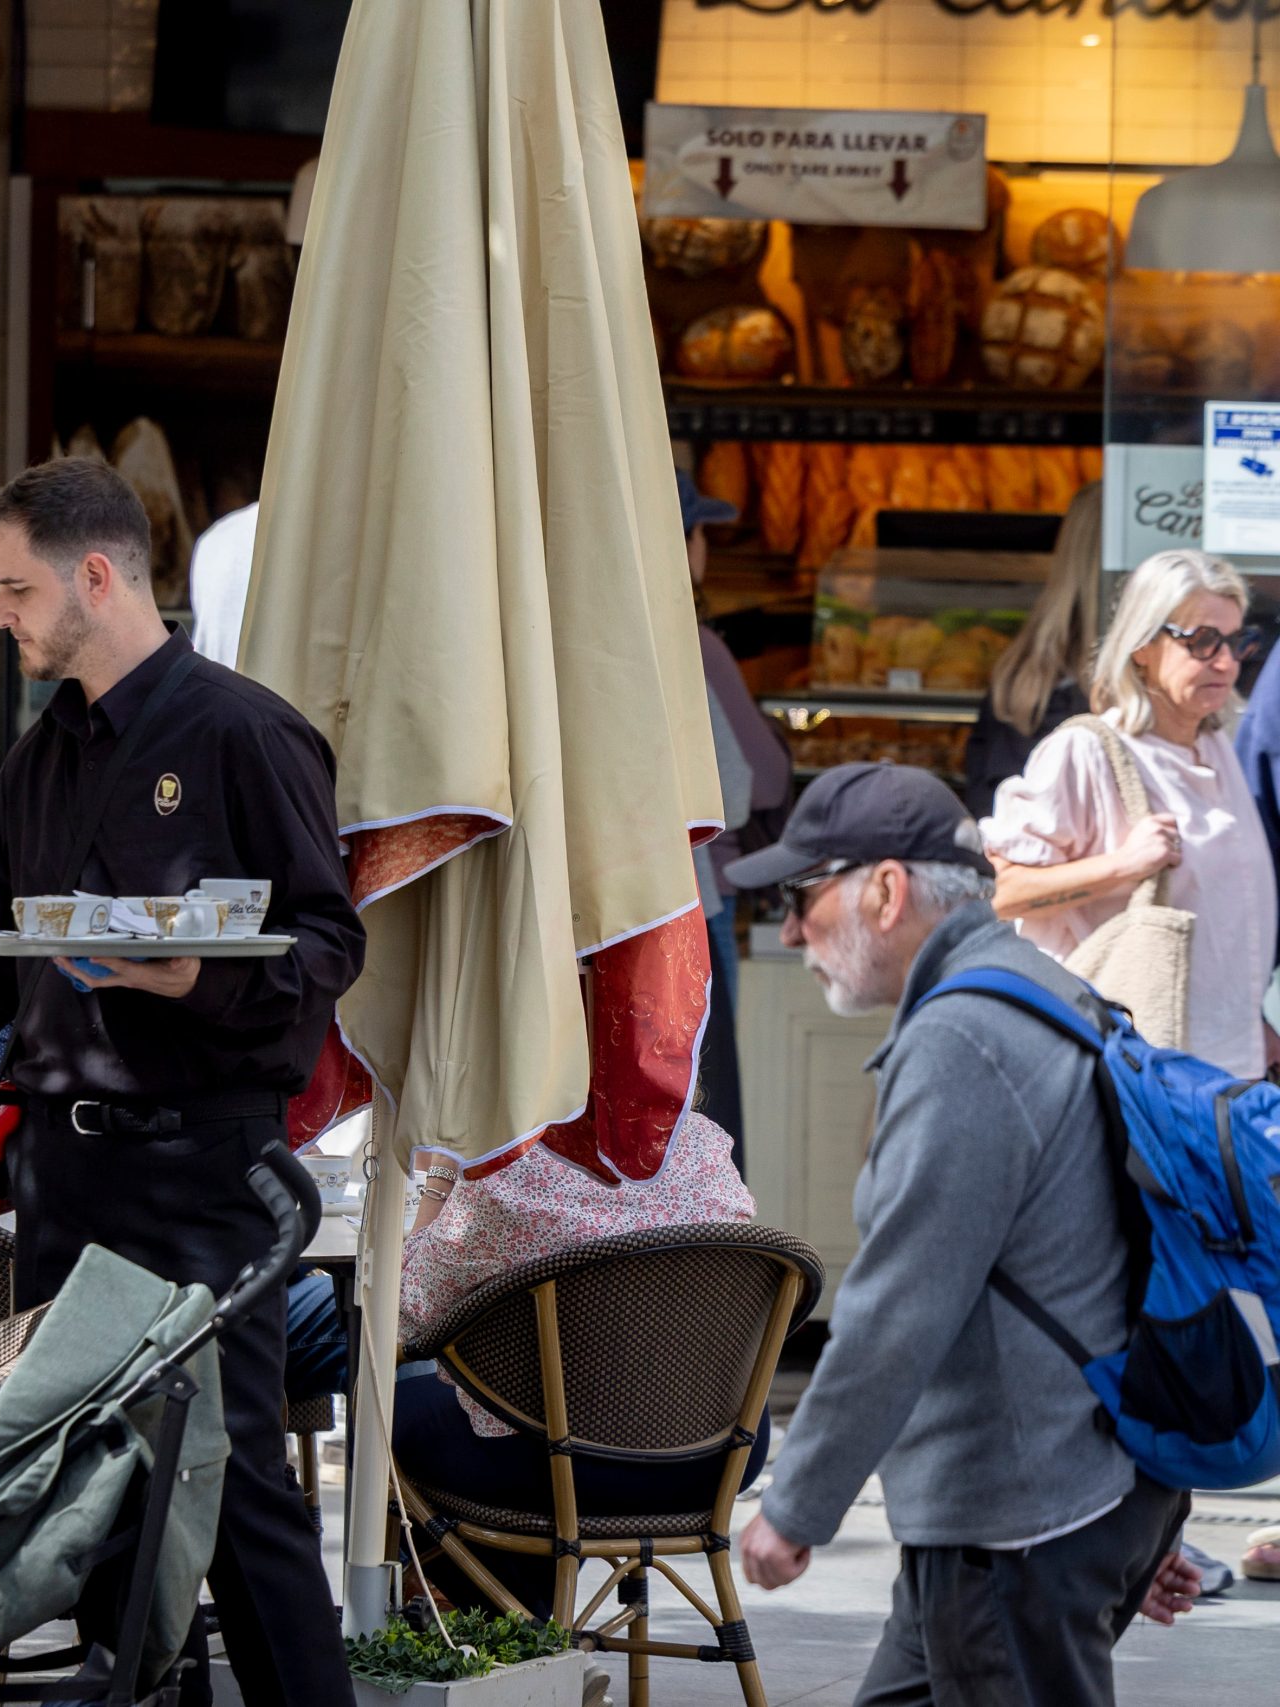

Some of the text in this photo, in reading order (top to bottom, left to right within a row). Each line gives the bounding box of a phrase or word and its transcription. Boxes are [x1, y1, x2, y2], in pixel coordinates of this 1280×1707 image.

[706, 128, 927, 152] SOLO PARA LLEVAR
[742, 162, 785, 176] ONLY
